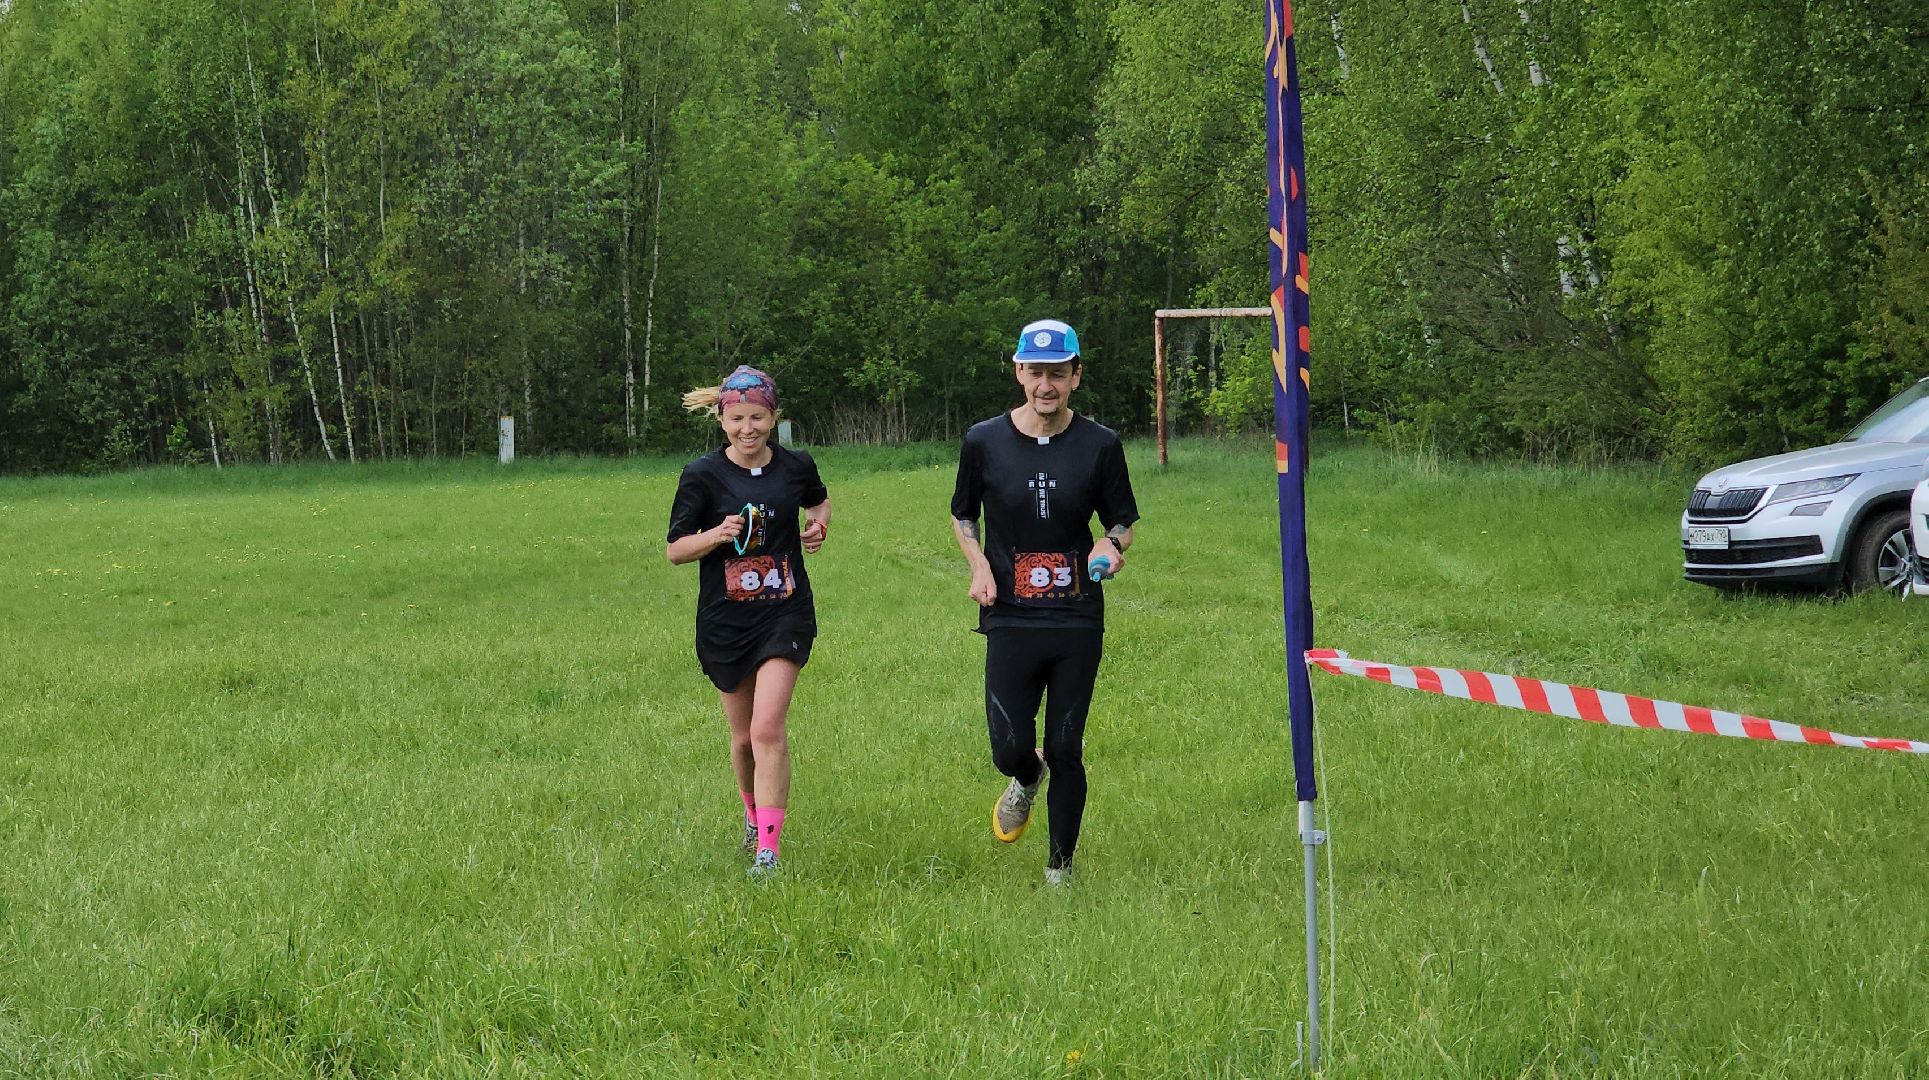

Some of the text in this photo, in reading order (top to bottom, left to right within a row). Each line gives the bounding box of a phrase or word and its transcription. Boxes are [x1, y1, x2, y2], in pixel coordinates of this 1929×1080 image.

[1039, 489, 1046, 499] WE
[741, 568, 782, 590] 84
[1030, 567, 1072, 587] 83
